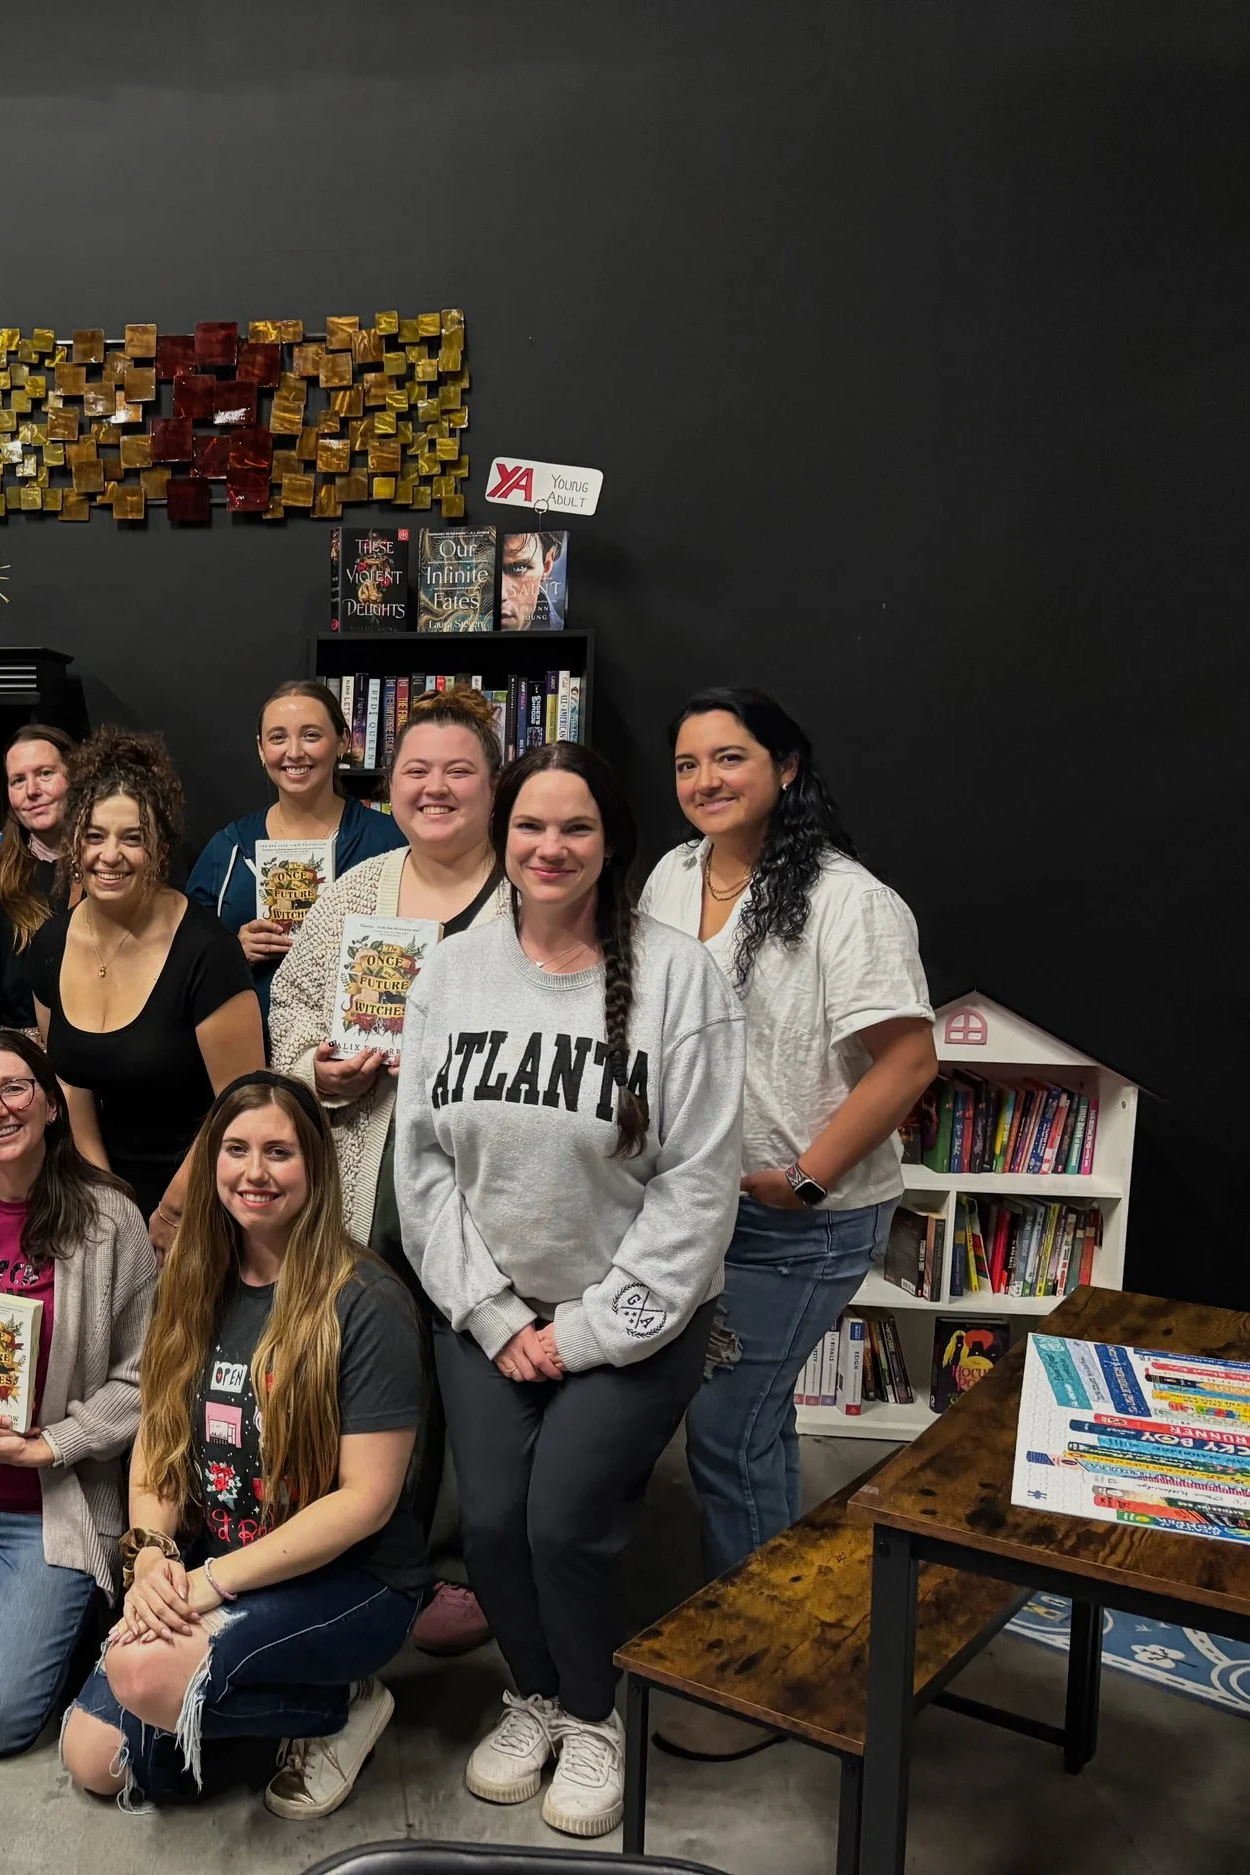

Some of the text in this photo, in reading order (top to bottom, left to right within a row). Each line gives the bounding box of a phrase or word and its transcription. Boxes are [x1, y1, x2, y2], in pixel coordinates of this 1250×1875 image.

[487, 463, 534, 502] YA
[552, 474, 588, 492] YOUNG
[546, 492, 586, 508] ADULT
[355, 539, 394, 556] THESE
[439, 540, 476, 558] Our
[346, 565, 402, 584] VIOLENT
[427, 566, 488, 584] Infinite
[508, 582, 562, 598] SAINT
[342, 598, 406, 618] DELIGHTS
[434, 592, 480, 610] Fates
[398, 697, 408, 727] THE FINAL
[385, 692, 396, 753] THE HAWTHORNE LEGACY
[278, 871, 307, 880] ONCE
[275, 890, 314, 898] FUTURE
[273, 910, 308, 919] WITCH
[367, 955, 403, 967] ONCE
[360, 976, 408, 990] FUTURE
[216, 1367, 243, 1386] OPEN
[1140, 1432, 1194, 1447] BOY
[1170, 1426, 1246, 1445] RUNNER
